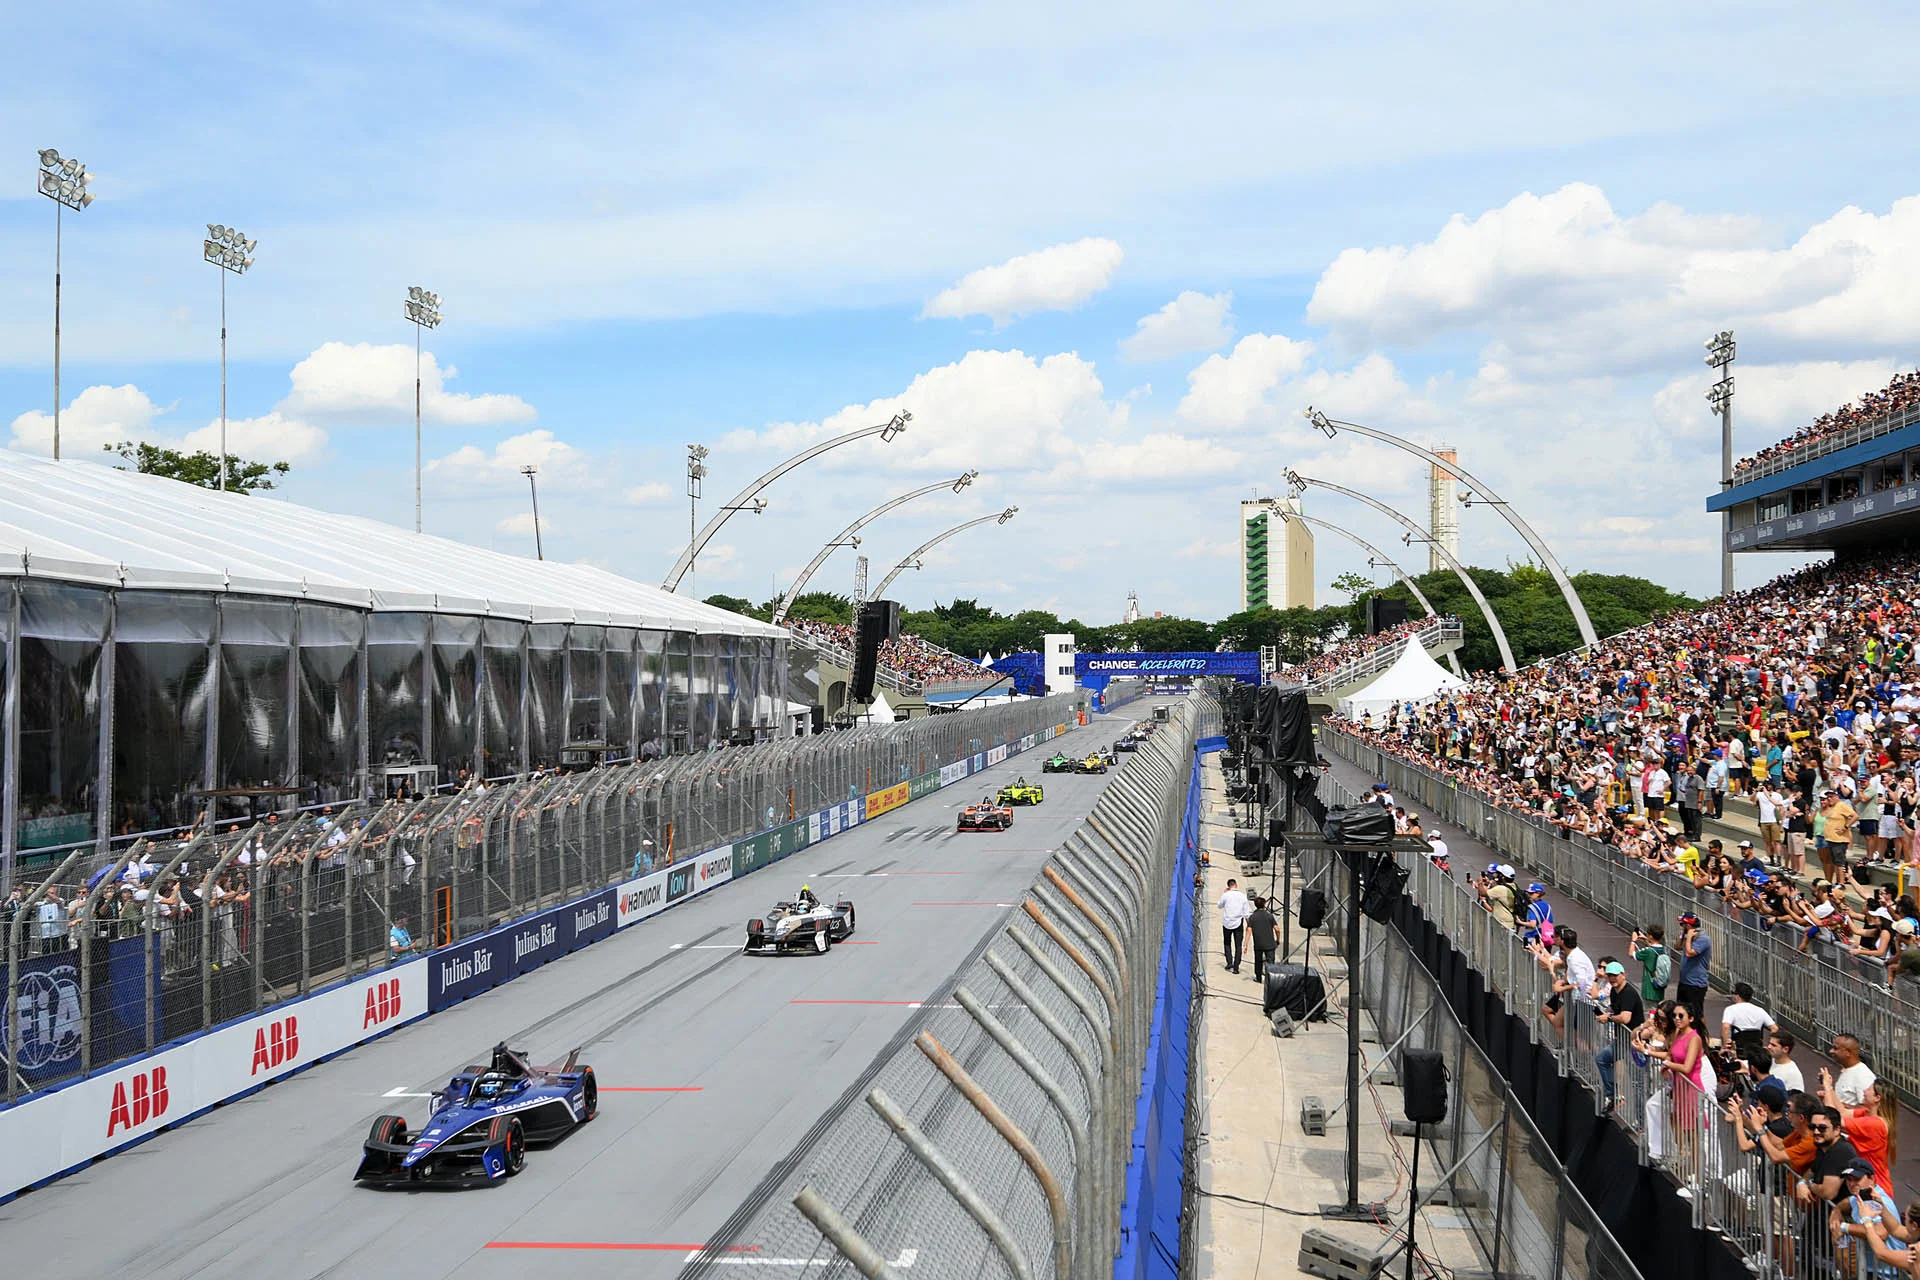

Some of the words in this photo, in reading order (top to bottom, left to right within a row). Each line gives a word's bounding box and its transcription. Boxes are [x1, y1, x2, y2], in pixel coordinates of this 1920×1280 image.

[514, 931, 540, 964] Julius
[540, 922, 556, 947] Bär
[575, 908, 596, 939] Julius
[597, 901, 610, 924] Bär
[441, 957, 472, 995] Julius
[473, 948, 492, 976] Bär
[363, 978, 402, 1030] ABB
[251, 1015, 299, 1076] ABB
[107, 1066, 169, 1138] ABB
